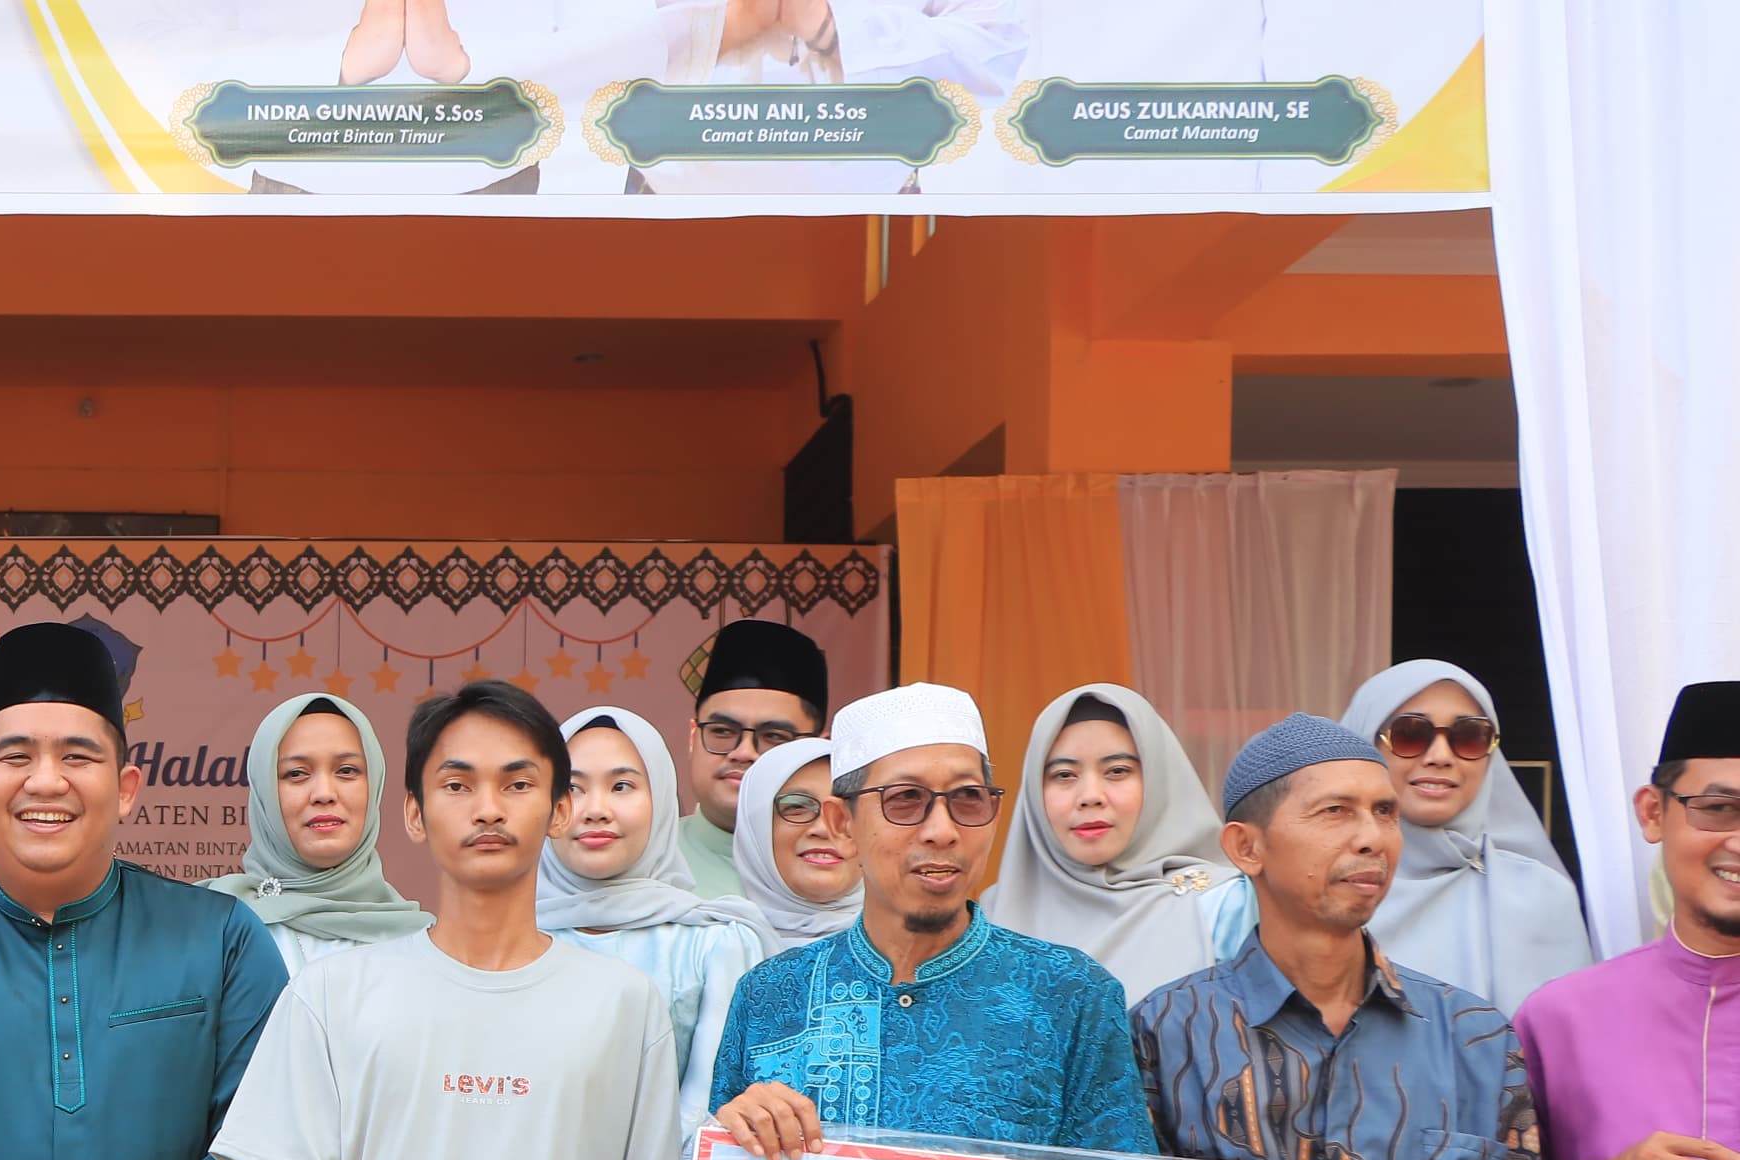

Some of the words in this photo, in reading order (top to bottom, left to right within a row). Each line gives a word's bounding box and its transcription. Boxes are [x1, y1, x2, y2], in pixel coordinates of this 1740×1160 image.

[247, 104, 310, 120] INDRA
[316, 104, 429, 124] GUNAWAN,
[434, 104, 483, 122] S.Sos
[689, 103, 758, 120] ASSUN
[766, 103, 810, 123] ANI,
[817, 103, 867, 120] S.Sos
[1073, 102, 1131, 120] AGUS
[1137, 102, 1279, 122] ZULKARNAIN,
[1286, 101, 1310, 119] SE
[288, 129, 339, 143] Camat
[343, 129, 393, 143] Bintan
[400, 130, 444, 144] Timur
[702, 128, 754, 143] Camat
[758, 128, 808, 143] Bintan
[813, 128, 864, 142] Pesisir
[1124, 126, 1178, 139] Camat
[1182, 126, 1259, 142] Mantang
[118, 805, 209, 825] ATEN
